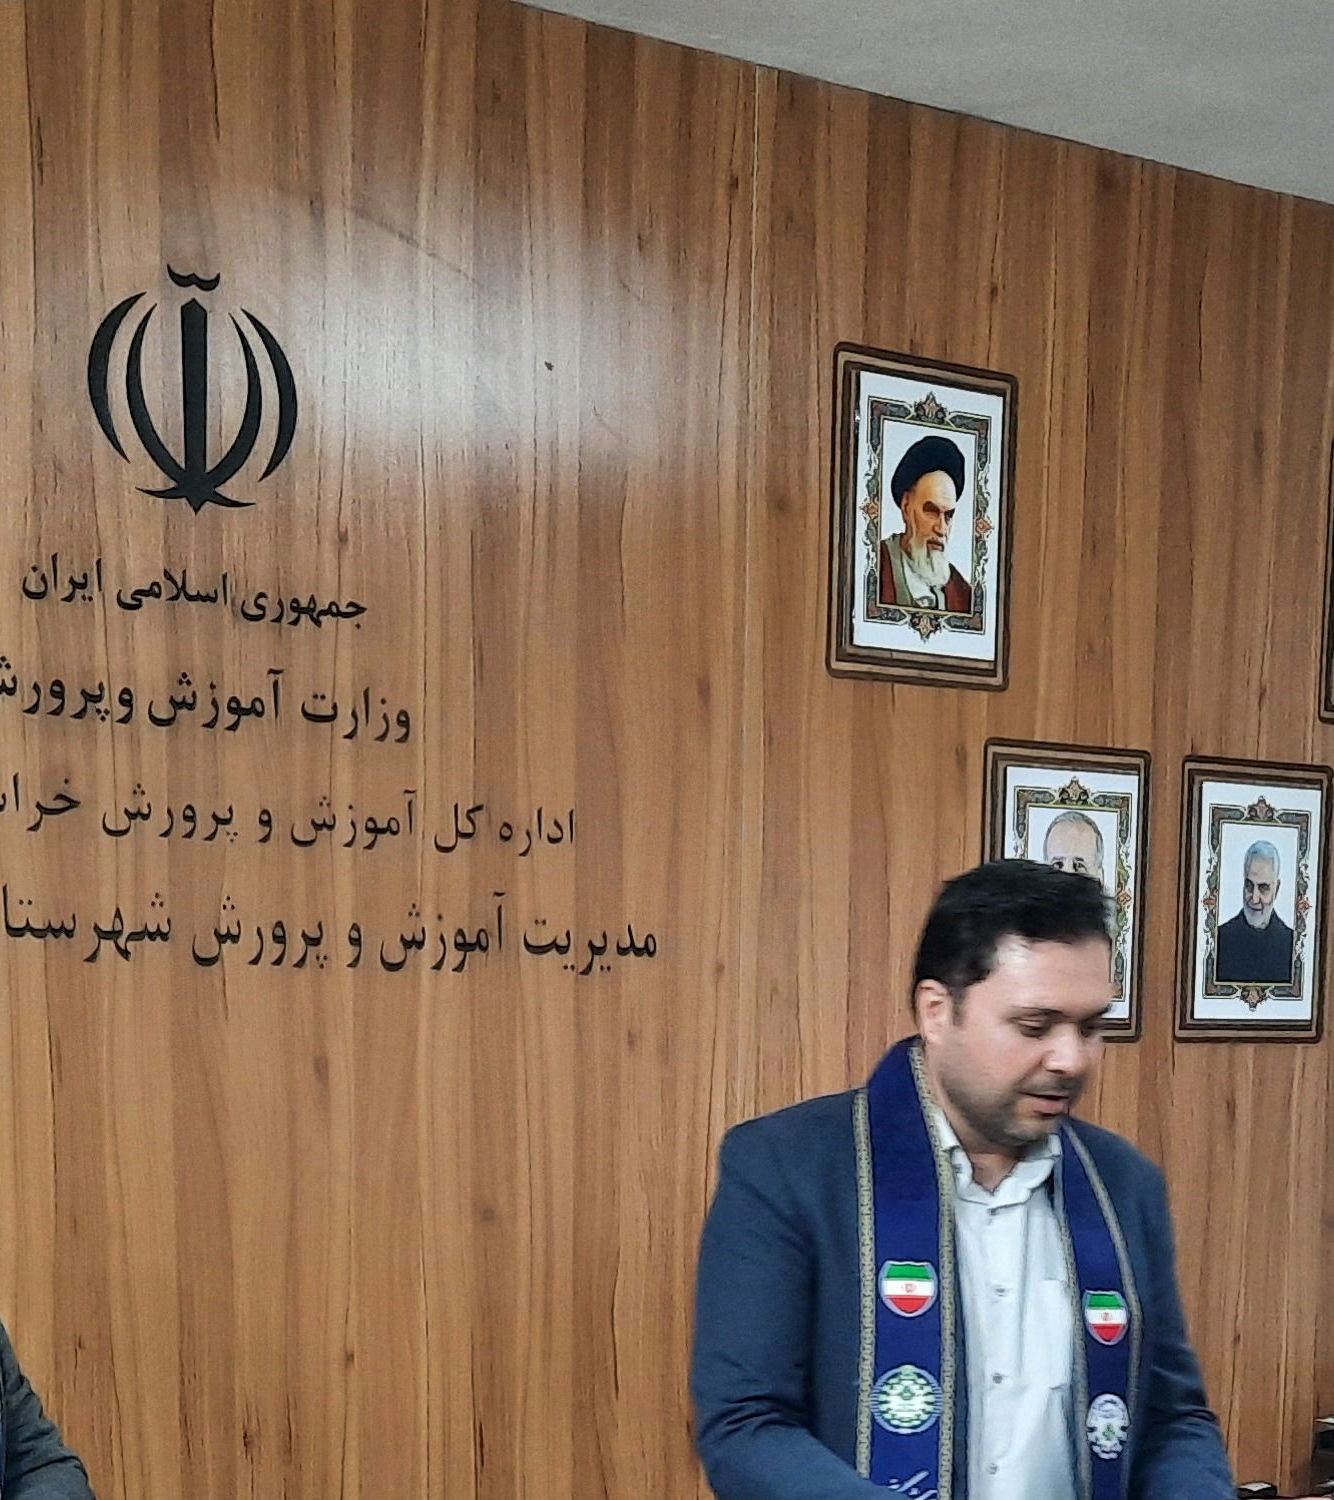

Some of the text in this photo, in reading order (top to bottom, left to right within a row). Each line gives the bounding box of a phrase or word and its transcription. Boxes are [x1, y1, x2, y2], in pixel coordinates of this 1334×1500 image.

[21, 551, 368, 631] جمهوری اسلامی ایران
[147, 667, 284, 732] آموزش
[300, 685, 413, 744] وزارت
[101, 780, 238, 845] پرورش
[257, 804, 274, 843] و
[289, 787, 418, 850] آموزش
[433, 801, 485, 854] کل
[498, 806, 576, 857] اداره
[191, 893, 332, 971] پرورش
[346, 920, 364, 970] و
[379, 890, 507, 975] آموزش
[521, 916, 659, 977] مدیریت
